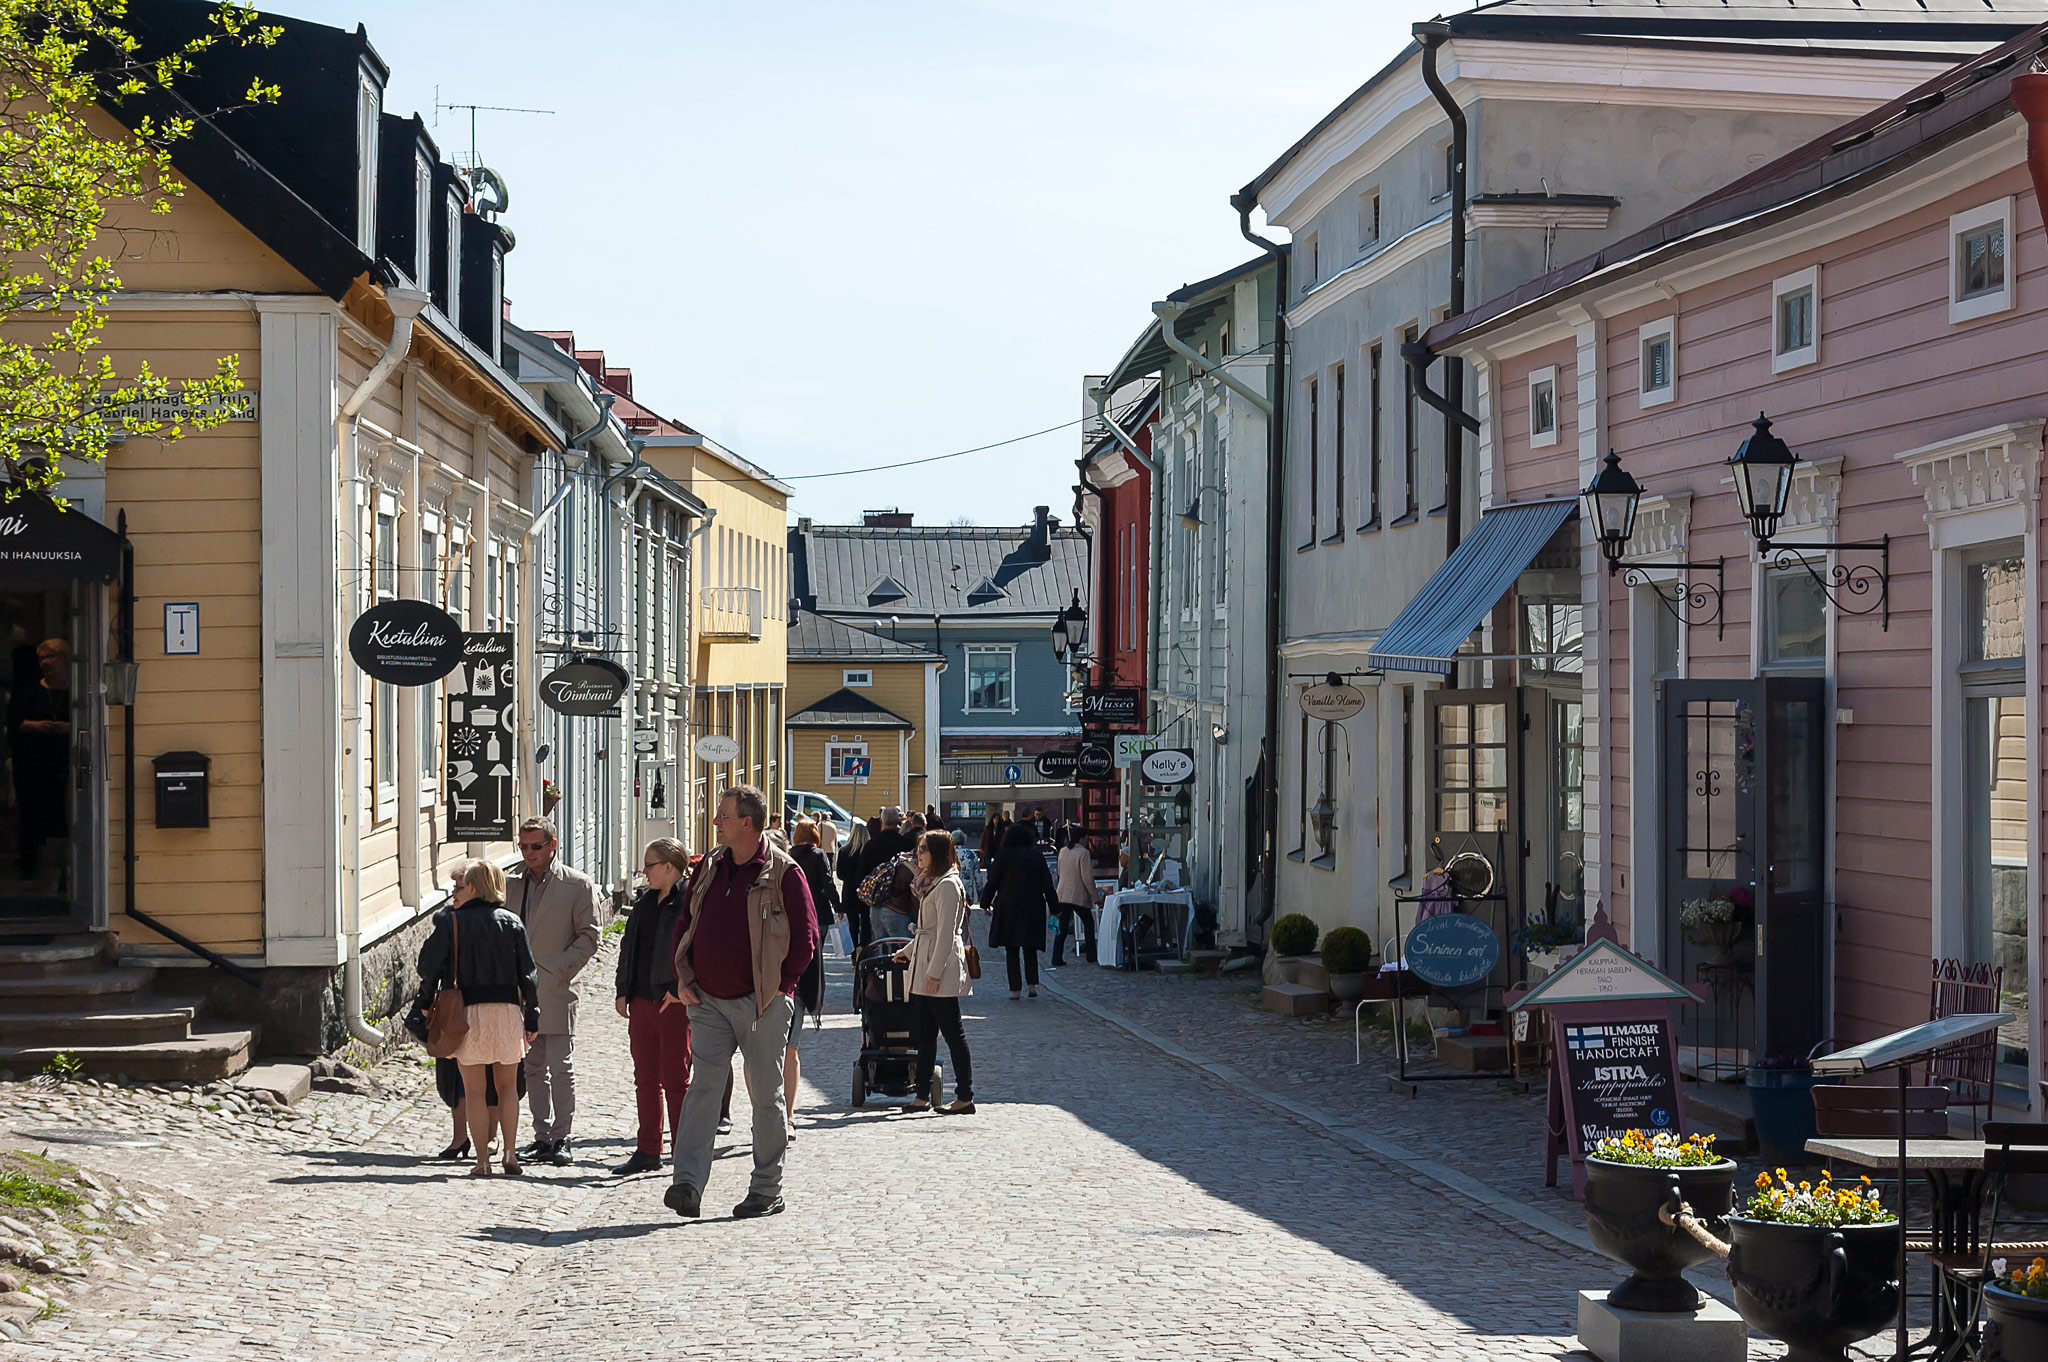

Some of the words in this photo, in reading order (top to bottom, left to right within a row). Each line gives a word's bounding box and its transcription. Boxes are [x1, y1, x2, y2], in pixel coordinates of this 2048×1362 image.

[12, 551, 82, 560] IHANUUKSIA
[367, 620, 447, 649] Kretuliini
[548, 680, 613, 703] Timbaali
[1303, 694, 1335, 706] Vanille
[1335, 694, 1362, 706] Home
[1084, 695, 1135, 712] Museo
[1411, 933, 1463, 956] Sininen
[1603, 1024, 1660, 1036] ILMATAR
[1611, 1036, 1656, 1047] FINNISH
[1575, 1046, 1660, 1061] HANDICRAFT
[1594, 1064, 1647, 1081] ISTRA
[1577, 1073, 1667, 1097] Kauppapaikka
